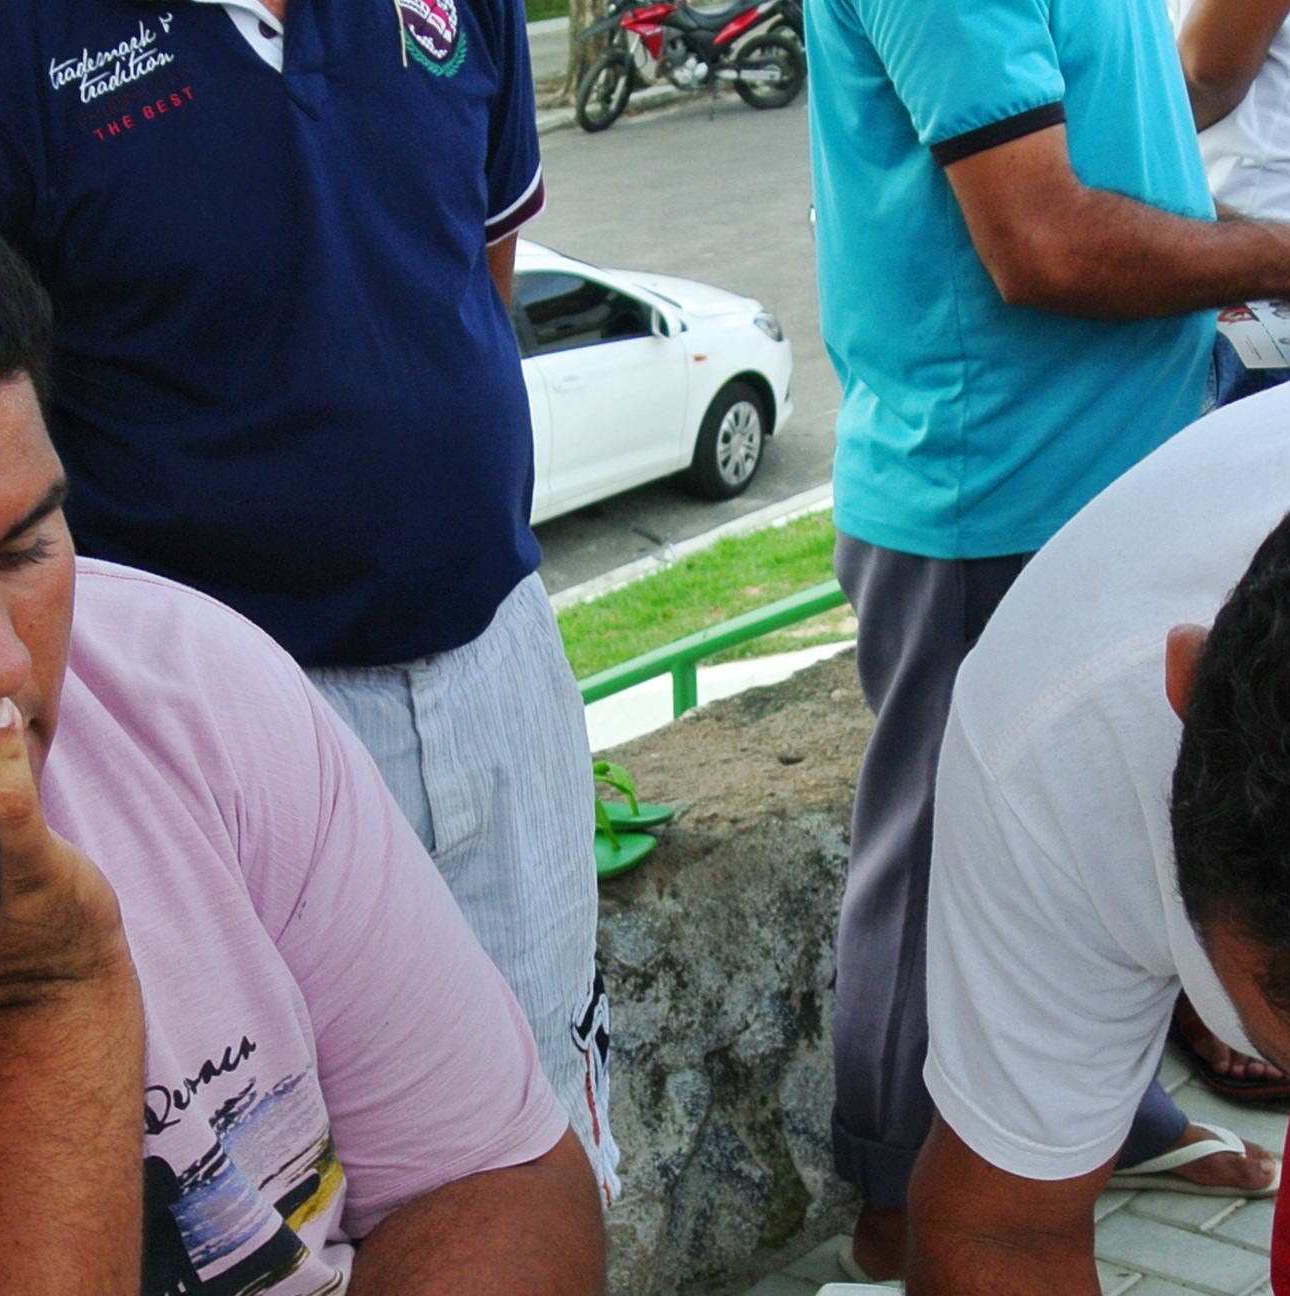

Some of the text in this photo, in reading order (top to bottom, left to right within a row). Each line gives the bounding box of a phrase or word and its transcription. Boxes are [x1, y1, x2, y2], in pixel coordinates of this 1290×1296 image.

[49, 20, 157, 90] trademark
[79, 48, 175, 103] tradition
[93, 114, 134, 140] THE
[141, 86, 193, 119] BEST
